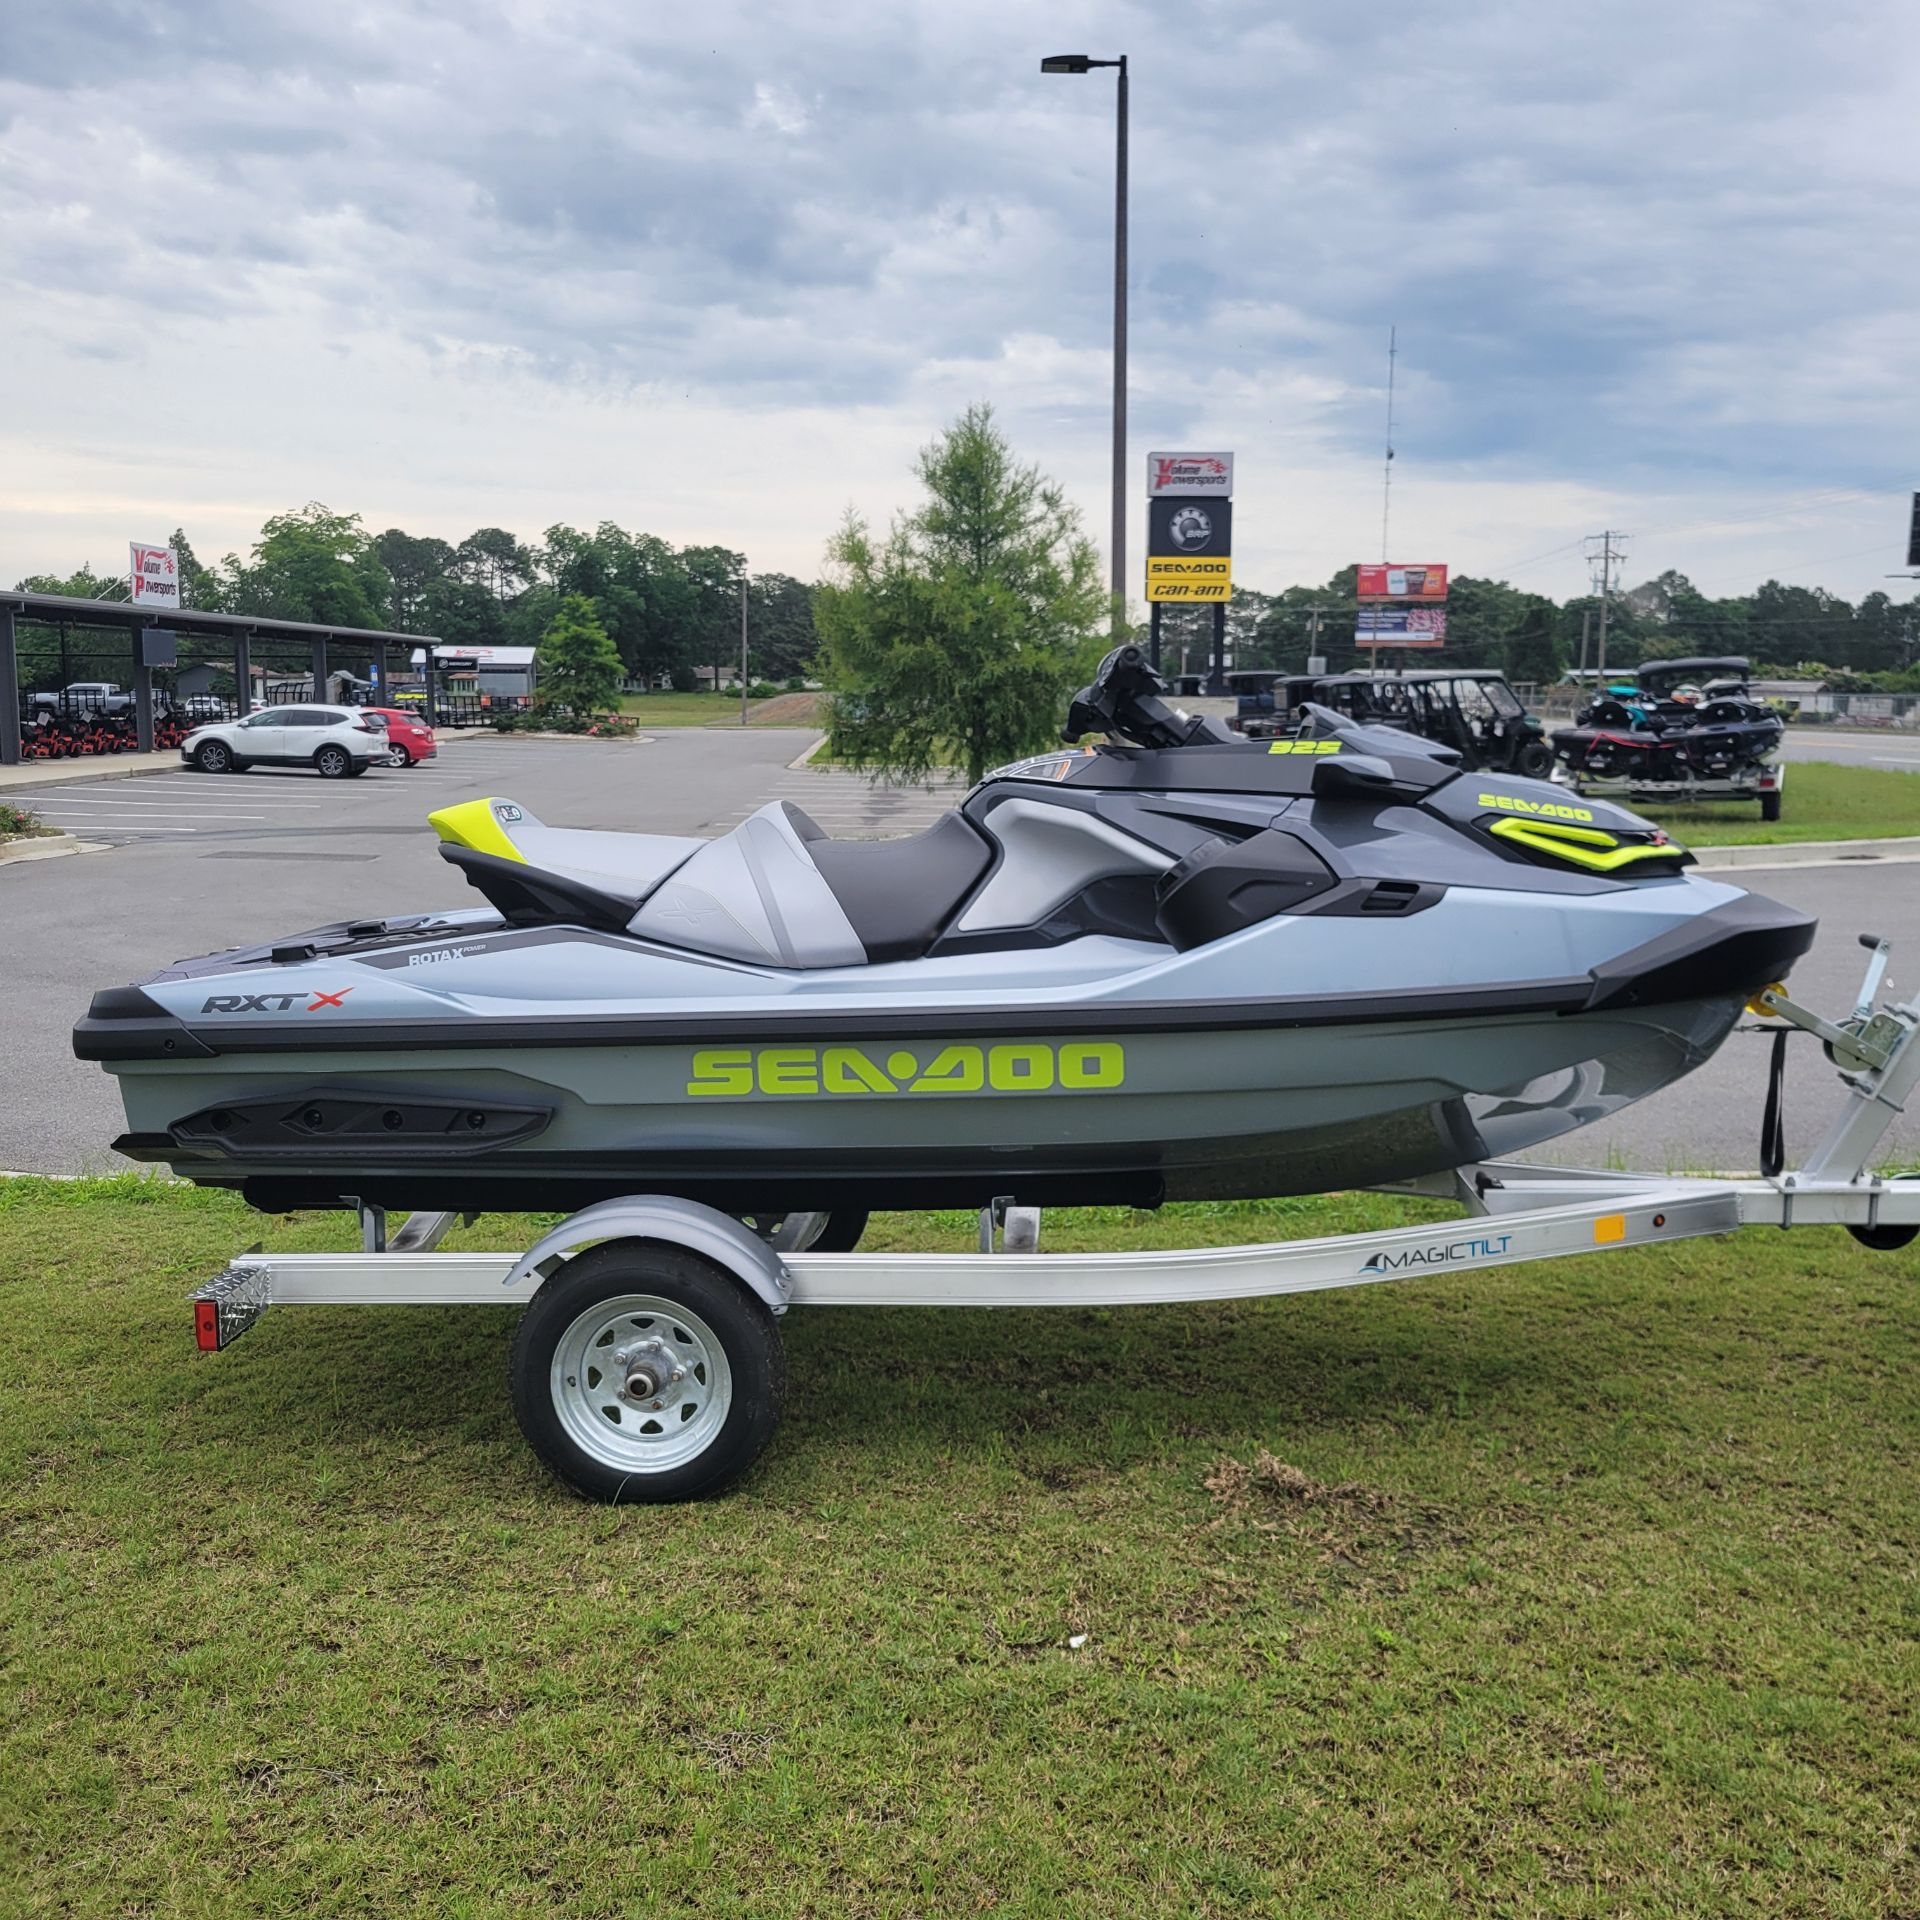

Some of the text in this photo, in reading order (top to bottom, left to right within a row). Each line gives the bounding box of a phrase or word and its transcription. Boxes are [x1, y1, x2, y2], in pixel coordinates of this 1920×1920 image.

[1154, 458, 1201, 475] Volume
[1153, 474, 1227, 490] Powersports
[1186, 530, 1211, 538] BRP
[132, 547, 161, 575] Volume
[133, 574, 177, 598] Powersports
[1154, 585, 1224, 595] can-am
[1267, 741, 1343, 755] 325
[408, 944, 487, 969] ROTAX POWER
